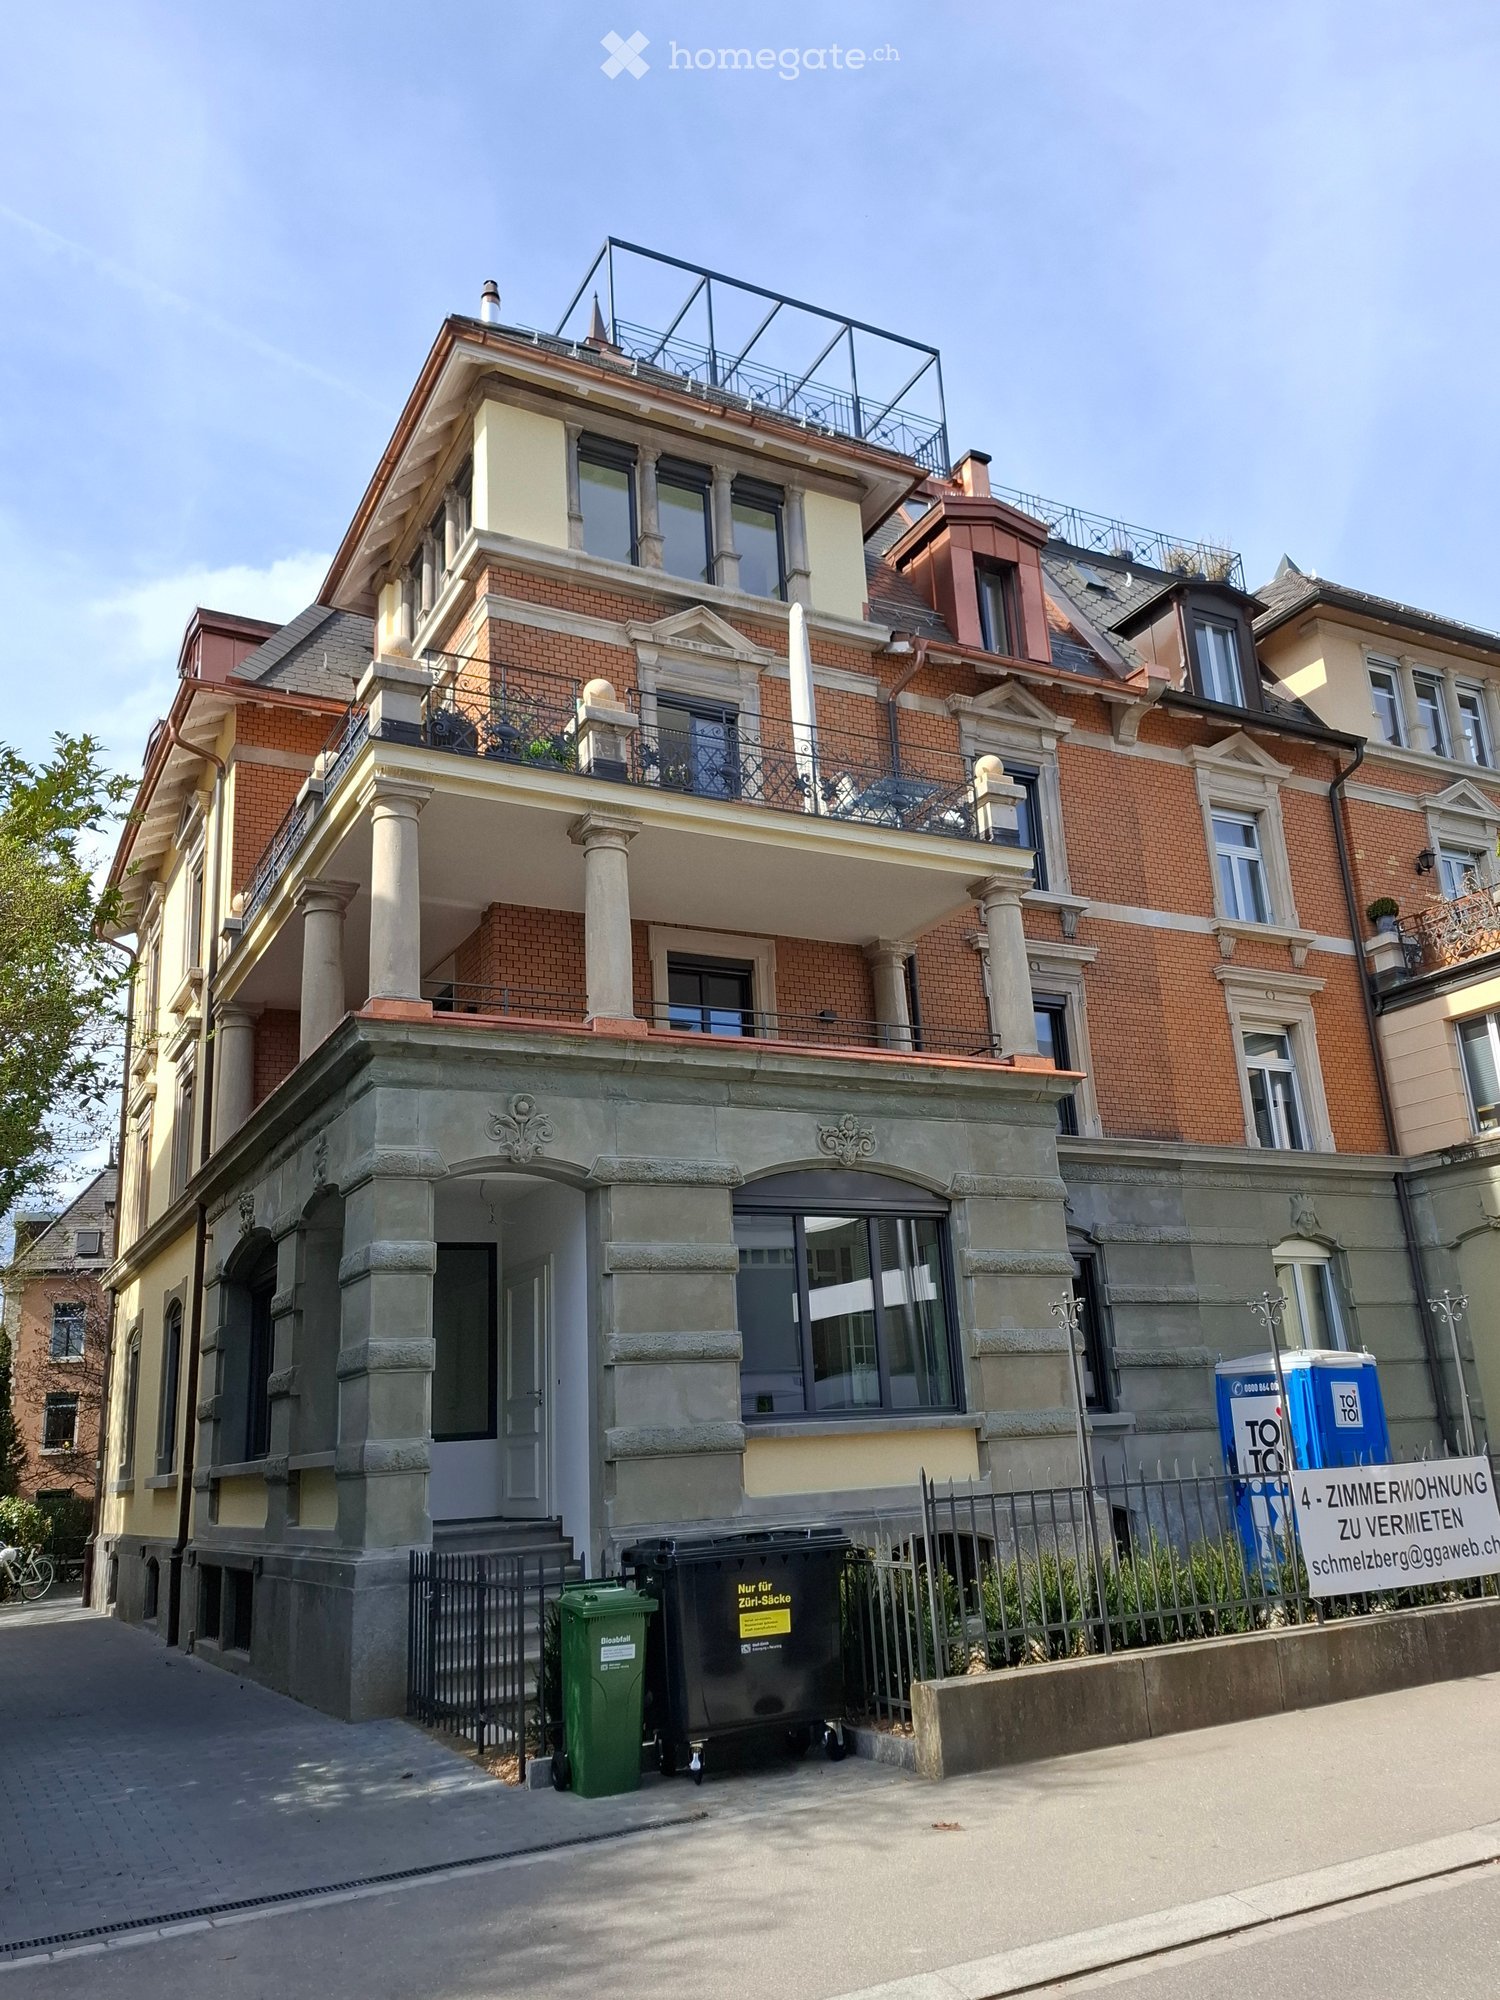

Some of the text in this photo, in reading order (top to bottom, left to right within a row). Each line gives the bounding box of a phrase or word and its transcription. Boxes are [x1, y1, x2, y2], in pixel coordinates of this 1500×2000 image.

[1339, 1394, 1357, 1408] TOI
[1341, 1408, 1359, 1422] TOI
[1325, 1471, 1488, 1509] ZIMMERWOHNUNG
[1338, 1507, 1464, 1541] ZU VERMIETEN
[1311, 1534, 1500, 1576] schmelzberg@ggaweb.ch
[738, 1581, 773, 1594] Nur für
[738, 1593, 792, 1609] Züri-Säcke
[600, 1634, 631, 1645] Bioabfall
